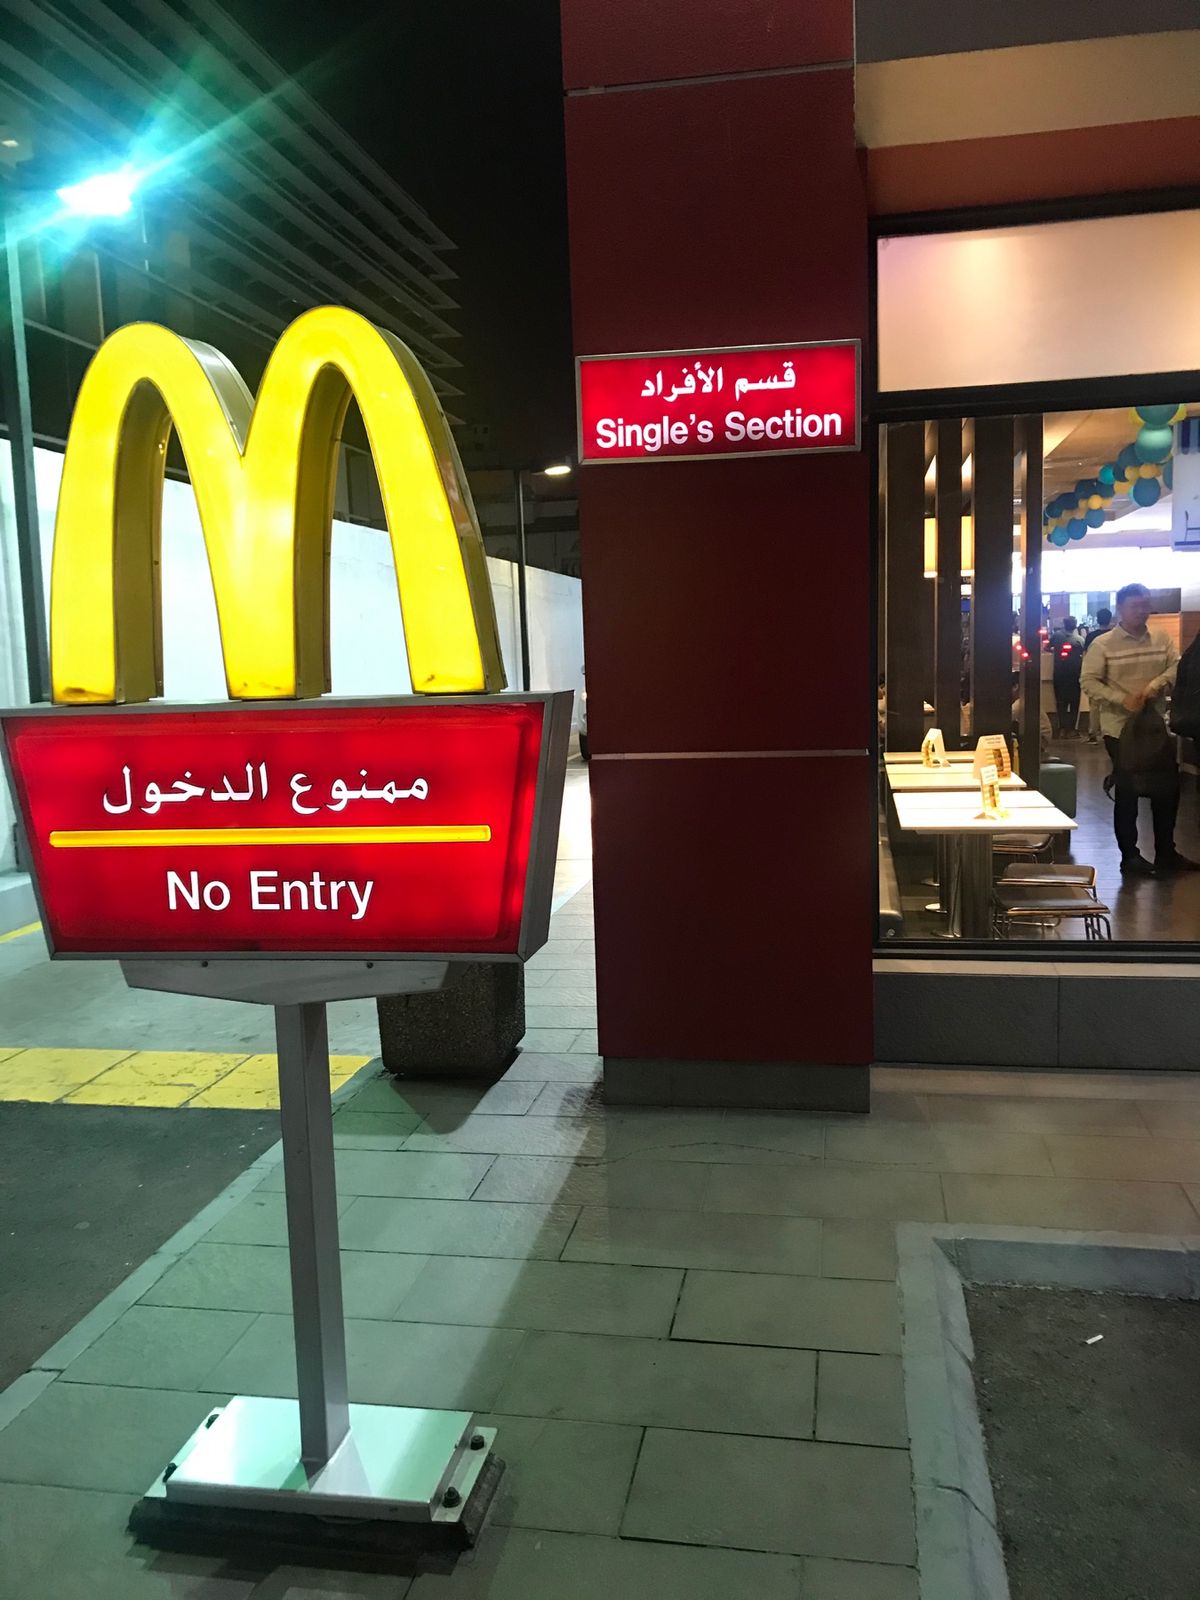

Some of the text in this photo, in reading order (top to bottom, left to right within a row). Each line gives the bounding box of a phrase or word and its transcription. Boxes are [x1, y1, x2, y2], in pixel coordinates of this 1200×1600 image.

[640, 361, 796, 403] قسم الأفراد
[724, 407, 842, 442] Section
[103, 761, 430, 815] ممنوع الدخول
[166, 870, 374, 920] No Entry
